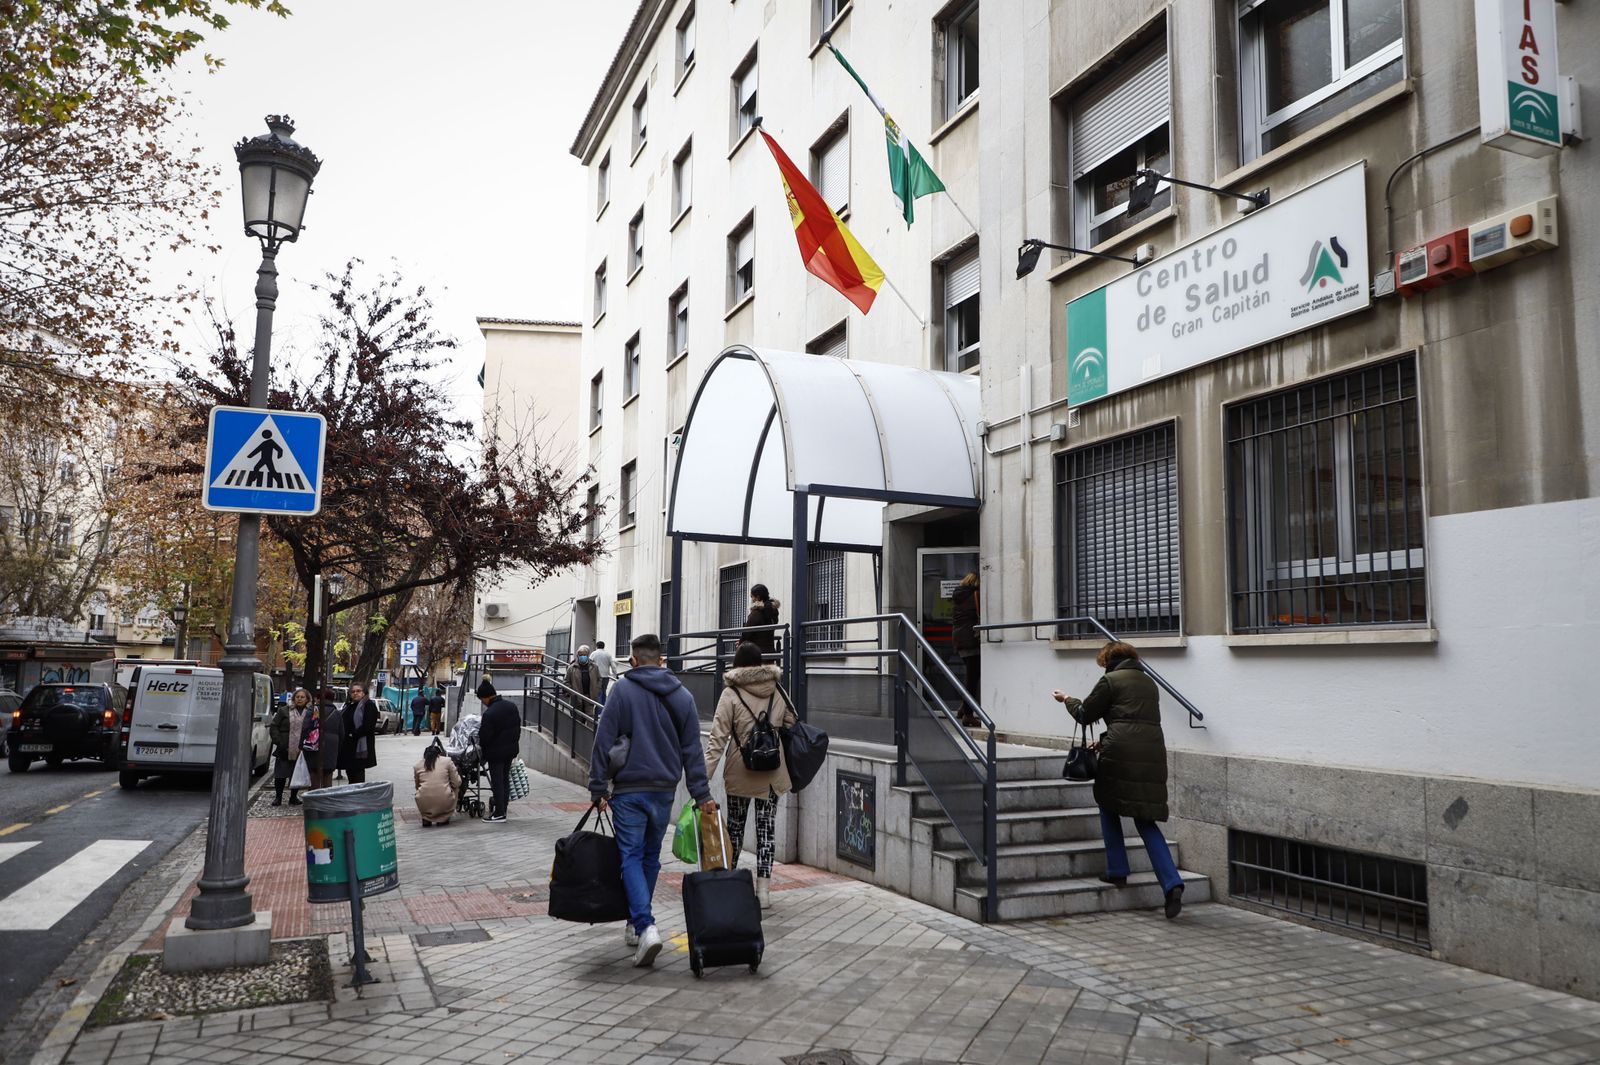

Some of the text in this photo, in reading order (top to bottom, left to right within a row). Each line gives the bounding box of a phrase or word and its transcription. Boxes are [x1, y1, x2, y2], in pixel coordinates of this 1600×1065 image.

[1136, 237, 1237, 297] Centro
[1137, 252, 1269, 332] de Salud
[1290, 302, 1310, 312] Servicio
[1312, 293, 1333, 304] Andaluz
[1344, 283, 1359, 293] Salud
[1290, 290, 1360, 318] Distrito Sanitario Granada
[1171, 289, 1270, 338] Gran Capitán
[403, 642, 415, 655] P
[146, 680, 189, 693] Hertz
[141, 747, 158, 755] 7204
